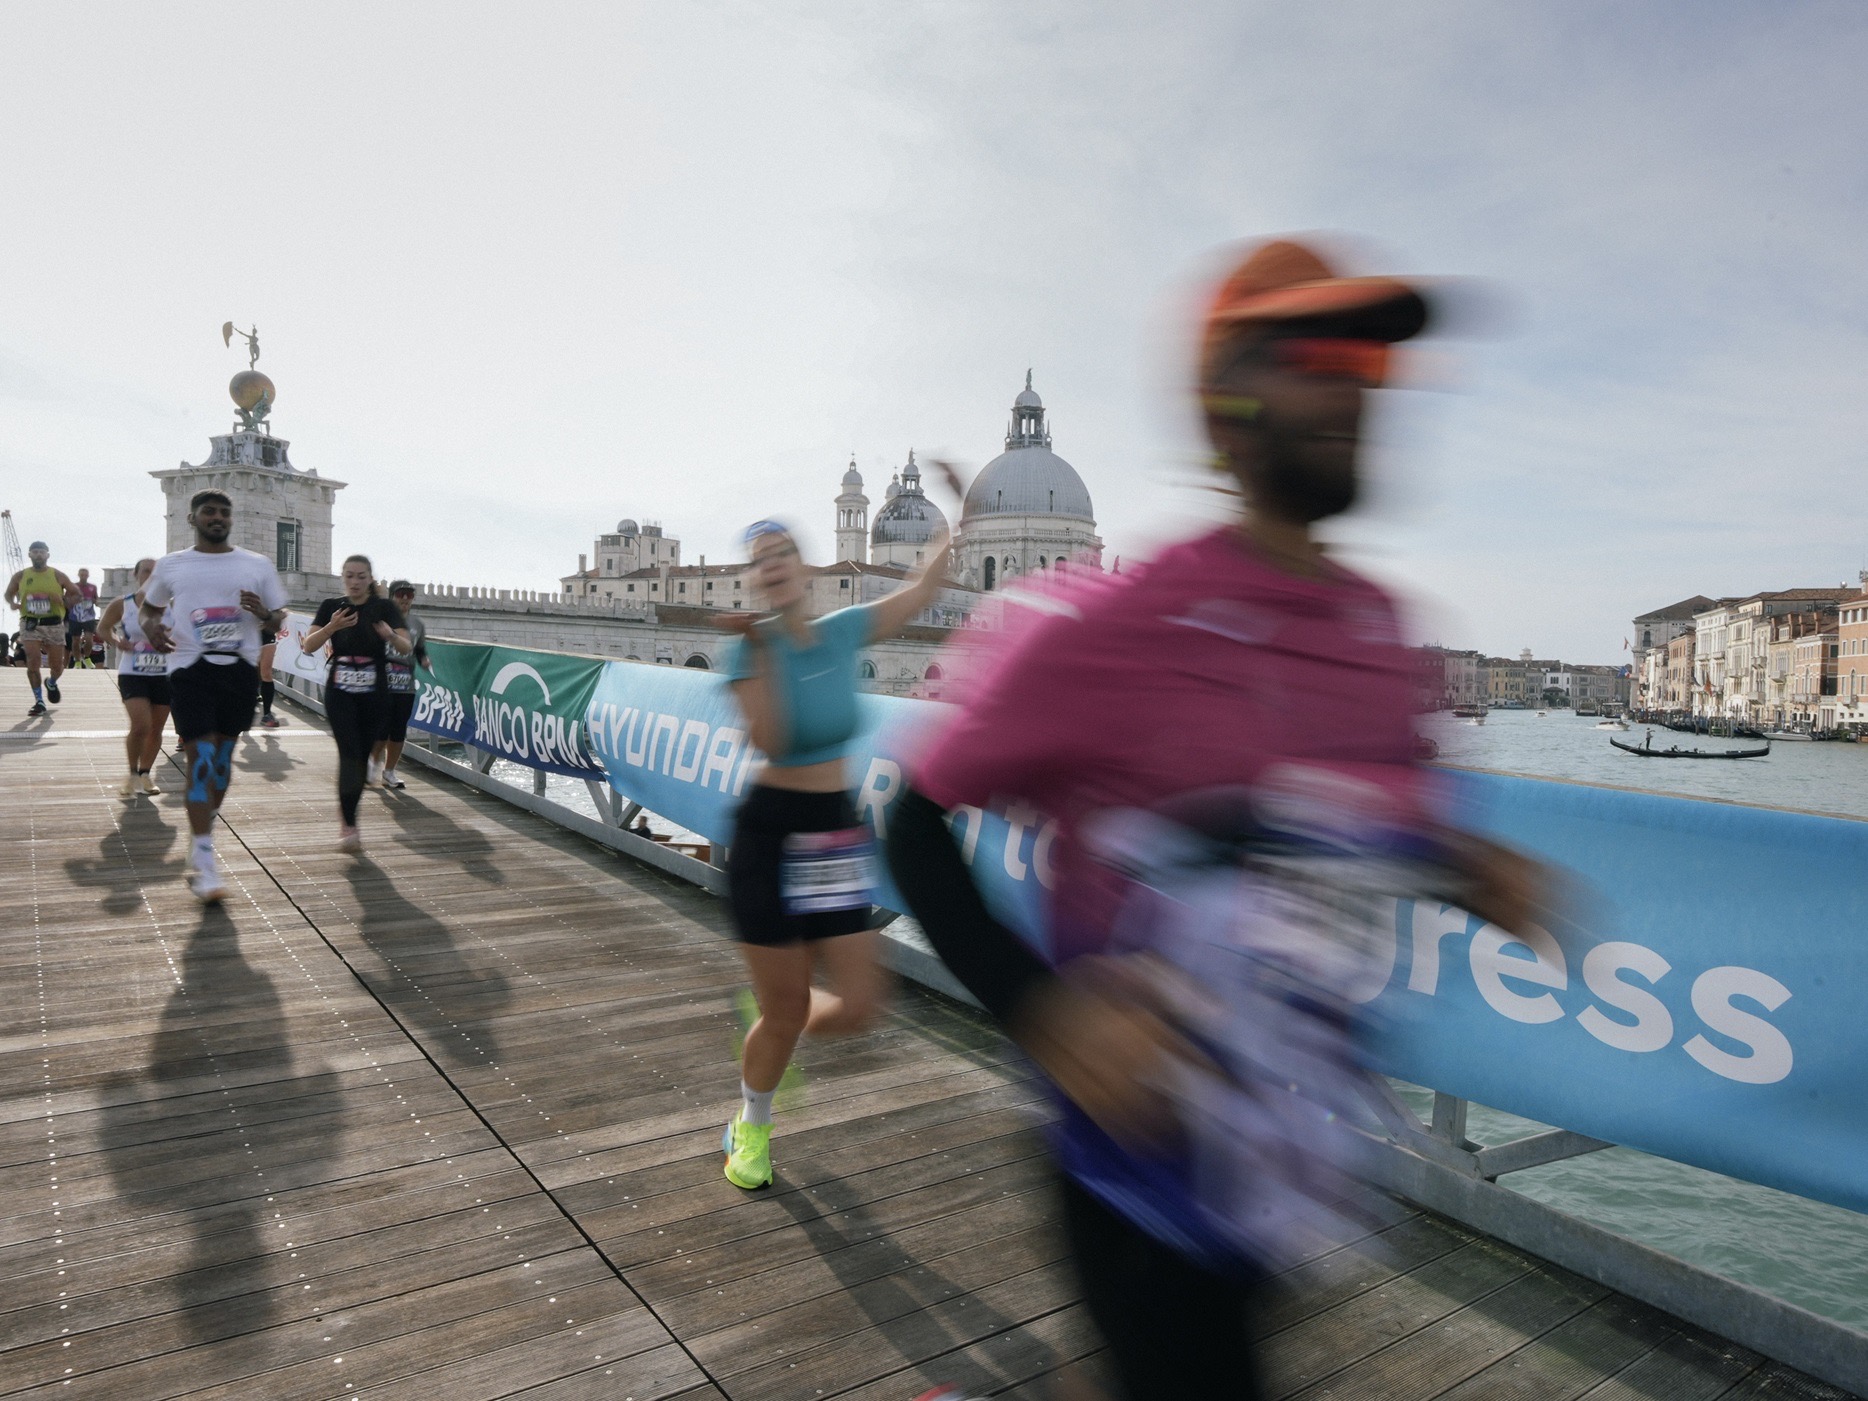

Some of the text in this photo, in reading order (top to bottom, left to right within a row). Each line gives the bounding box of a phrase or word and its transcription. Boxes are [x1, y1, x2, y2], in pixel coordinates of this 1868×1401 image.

[414, 682, 465, 732] BPM
[472, 695, 590, 770] BANCO BPM
[588, 701, 755, 797] HYUNDAI
[855, 757, 982, 866] Rn
